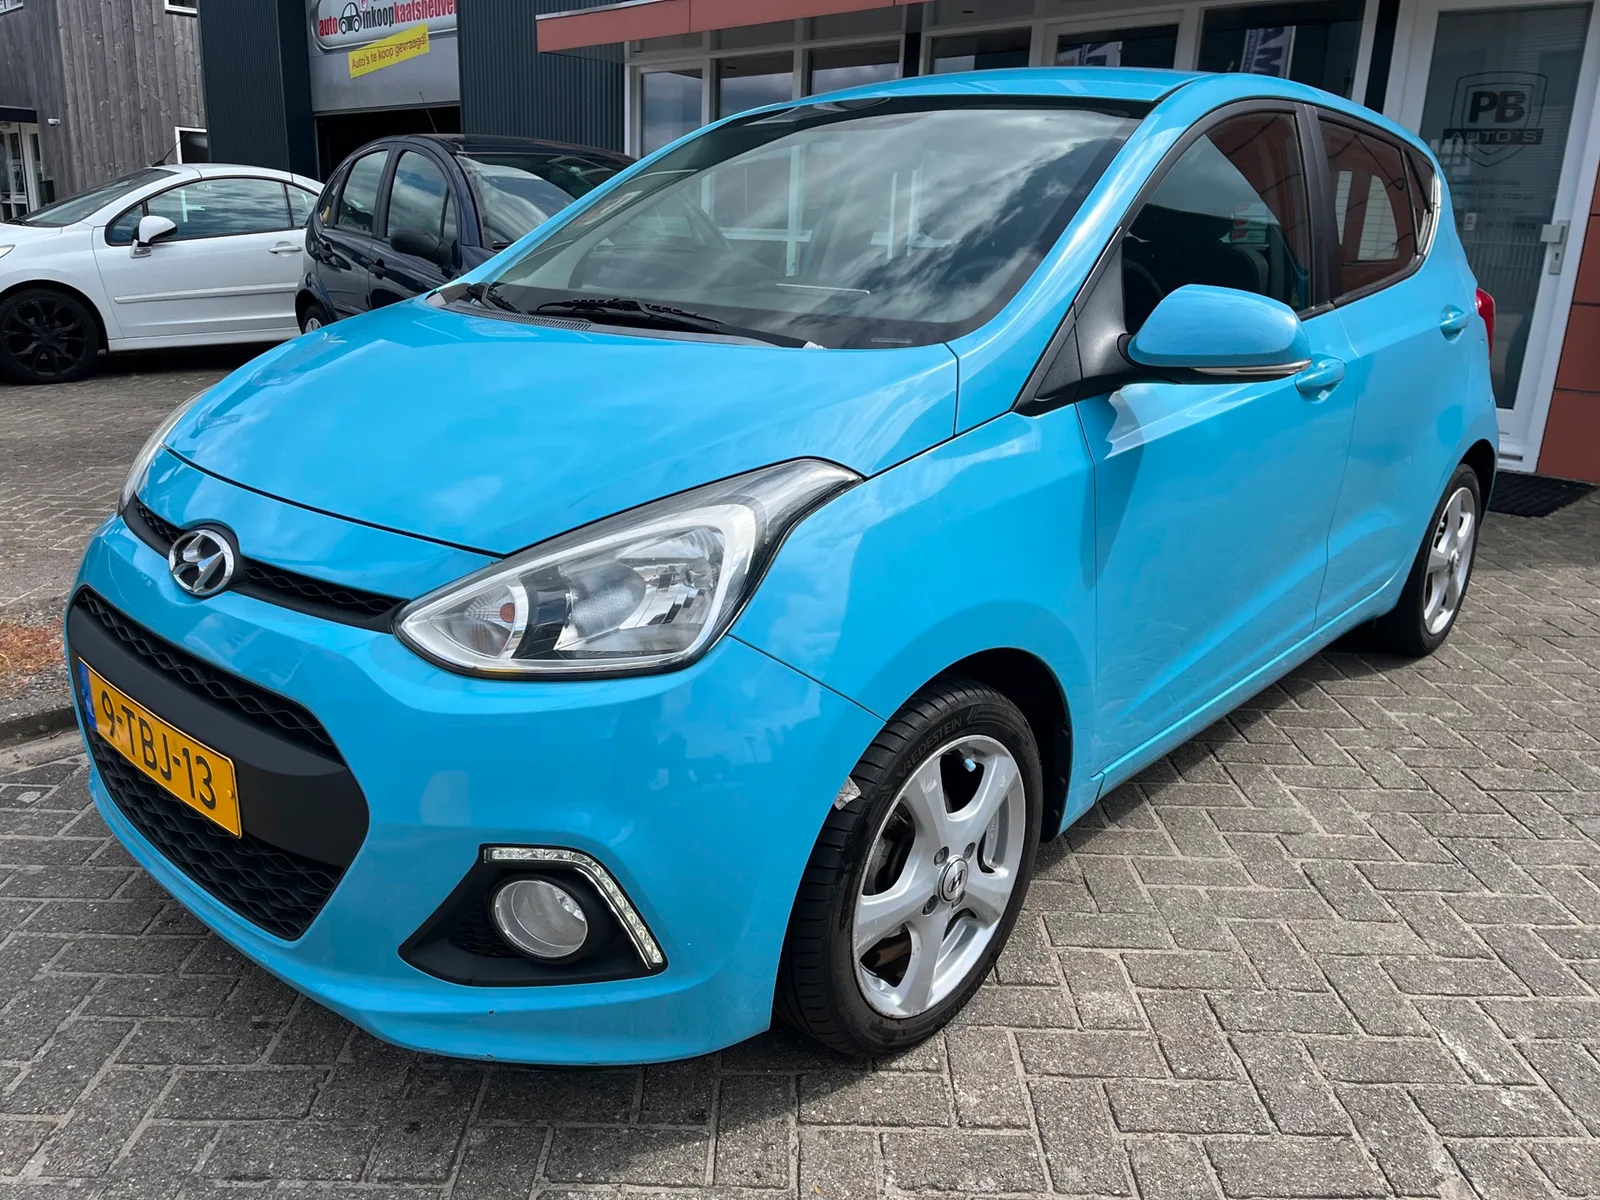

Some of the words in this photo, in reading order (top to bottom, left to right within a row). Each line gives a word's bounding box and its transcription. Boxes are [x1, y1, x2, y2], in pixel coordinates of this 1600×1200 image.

[352, 54, 370, 69] Auto's
[370, 52, 377, 63] te
[377, 48, 394, 59] koop
[1468, 90, 1526, 124] PB
[101, 689, 217, 810] 9-TBJ-13
[896, 715, 963, 778] VREDESTEIN
